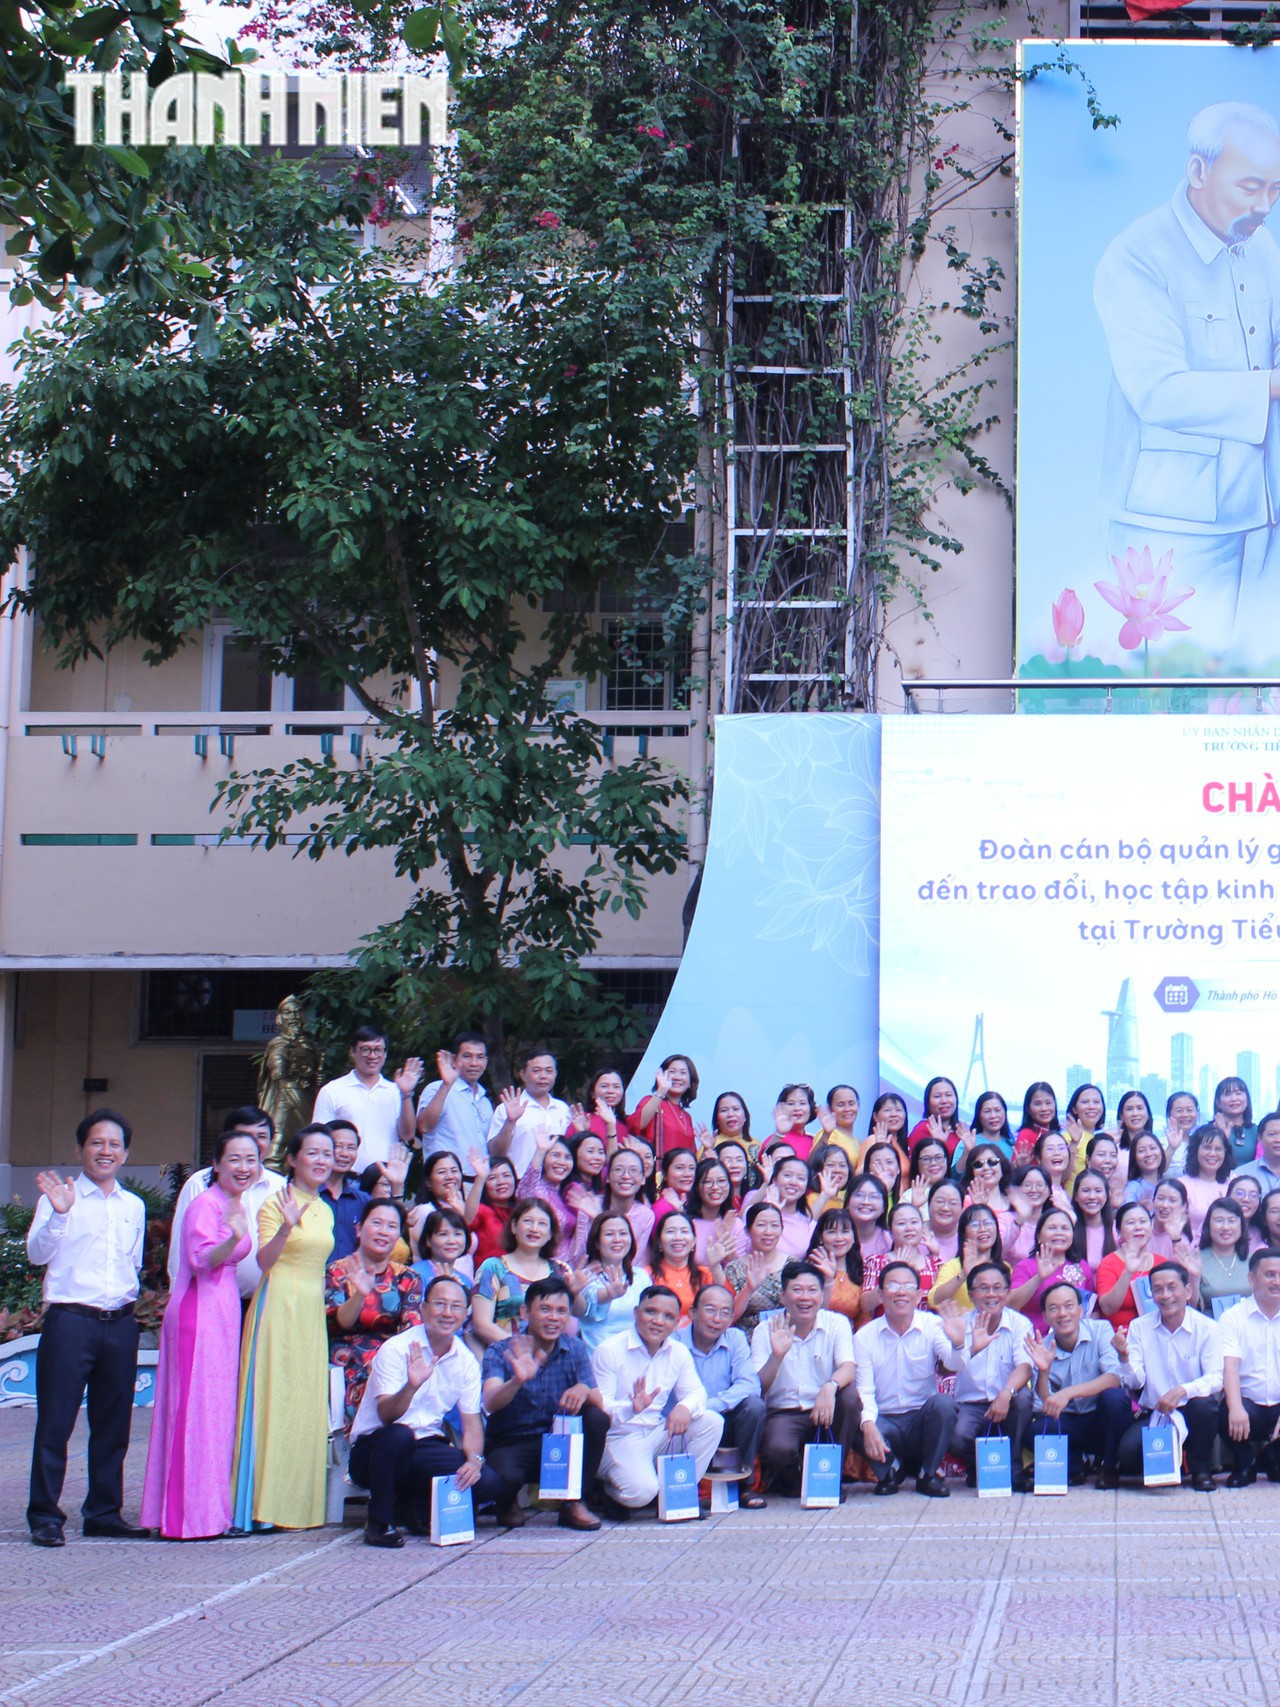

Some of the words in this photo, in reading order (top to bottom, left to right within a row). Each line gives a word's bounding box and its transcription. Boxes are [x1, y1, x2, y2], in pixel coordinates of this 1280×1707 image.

[1203, 727, 1230, 737] BAN
[978, 838, 1052, 860] Đoàn
[1059, 838, 1110, 860] cán
[1118, 838, 1152, 865] bộ
[1159, 835, 1229, 865] quản
[1237, 837, 1260, 865] lý
[917, 873, 968, 901] đến
[976, 880, 1037, 901] trao
[1044, 872, 1096, 903] đổi,
[1104, 879, 1153, 905] học
[1160, 877, 1209, 905] tập
[1217, 879, 1275, 900] kinh
[1077, 919, 1116, 945] tại
[1123, 918, 1224, 945] Trường
[1207, 990, 1238, 1001] Thành
